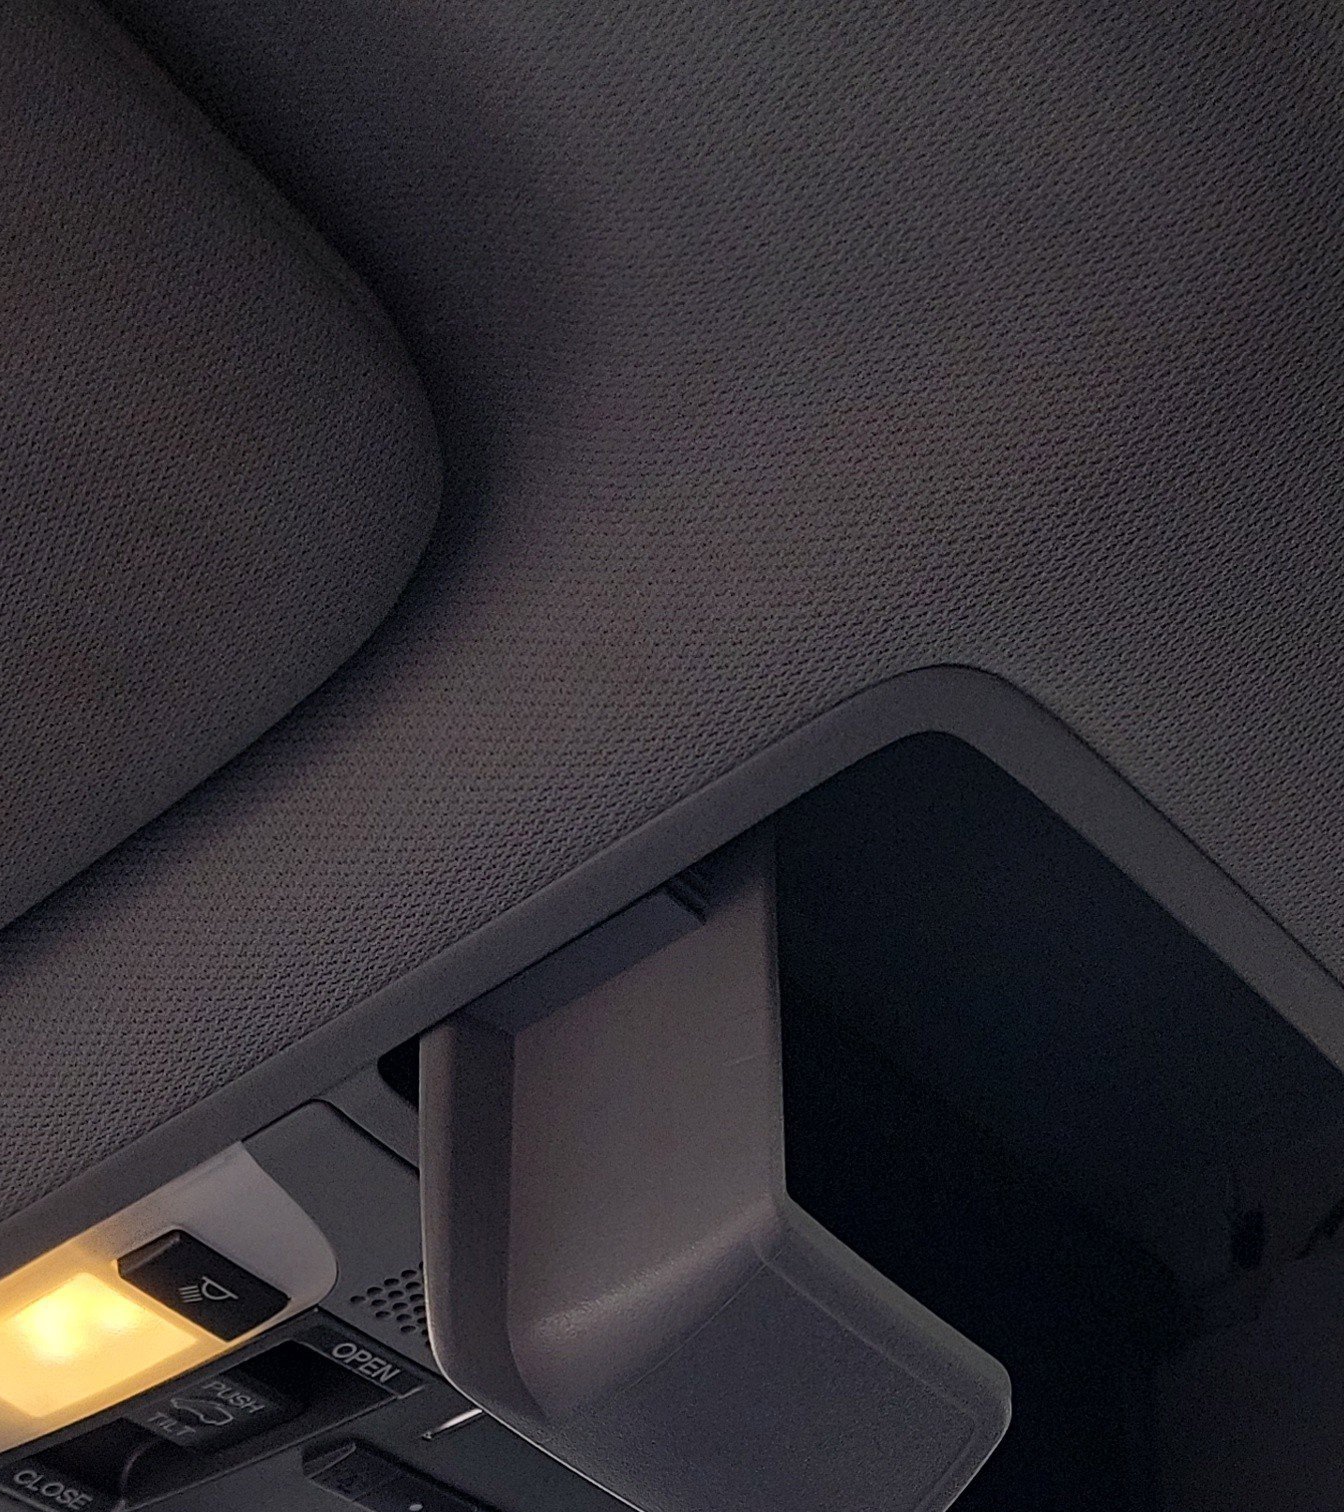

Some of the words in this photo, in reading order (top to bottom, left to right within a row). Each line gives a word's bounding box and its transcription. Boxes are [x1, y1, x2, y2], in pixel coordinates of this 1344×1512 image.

[332, 1341, 400, 1384] OPEN
[202, 1379, 266, 1415] PUSH
[149, 1410, 197, 1438] TILT
[13, 1469, 94, 1510] CLOSE
